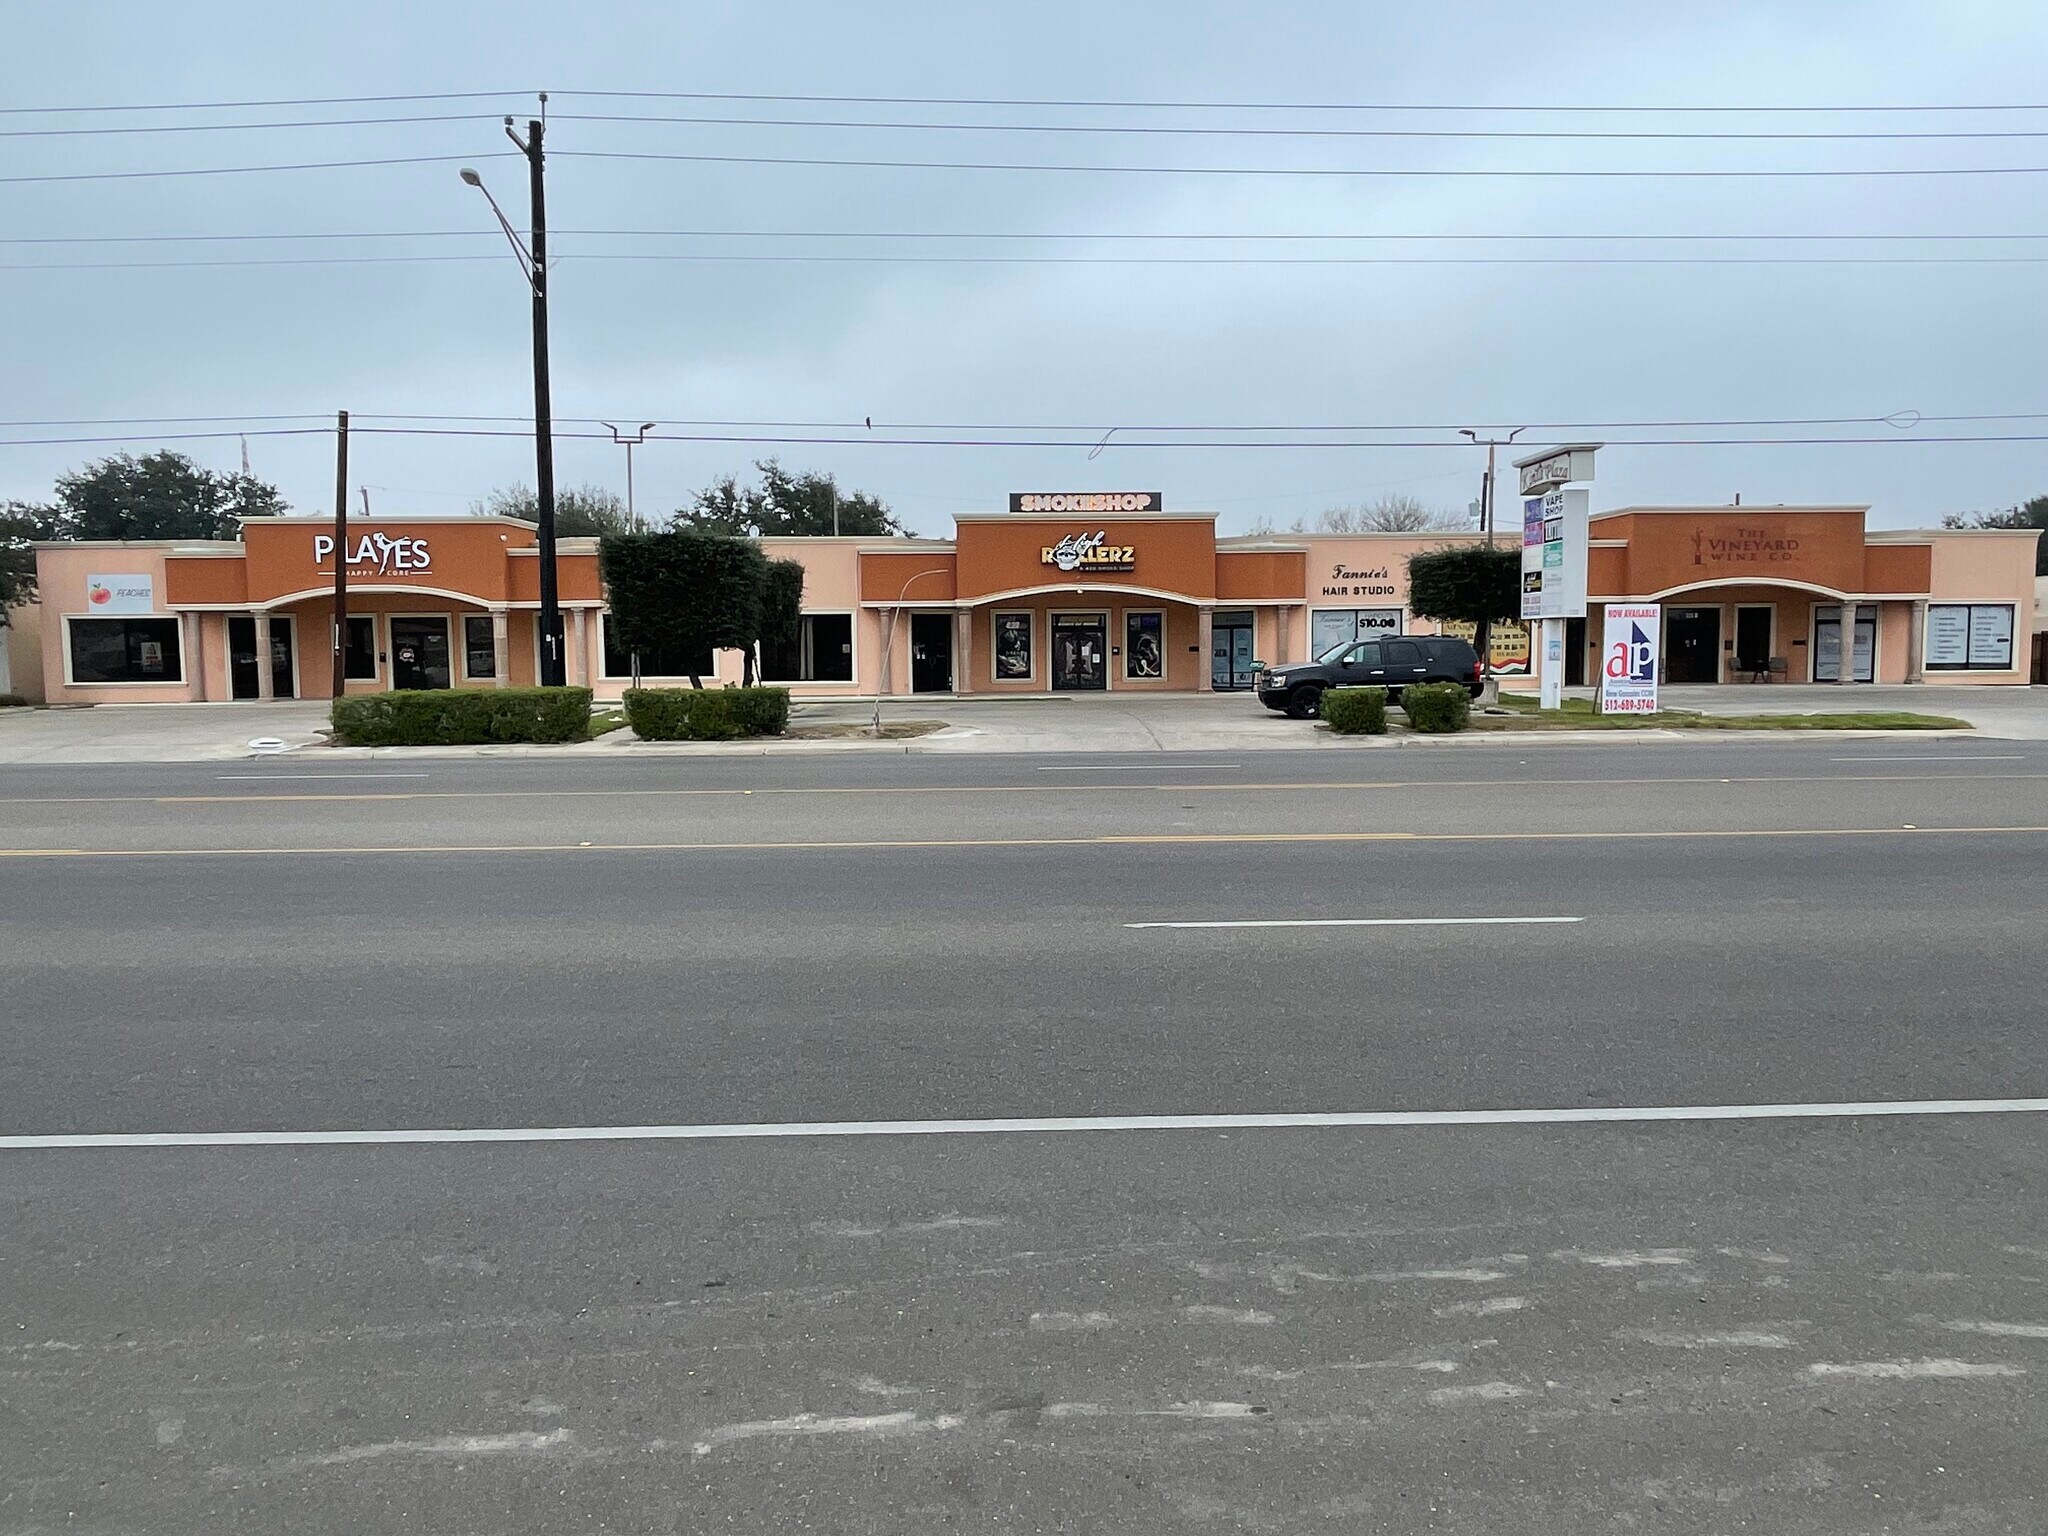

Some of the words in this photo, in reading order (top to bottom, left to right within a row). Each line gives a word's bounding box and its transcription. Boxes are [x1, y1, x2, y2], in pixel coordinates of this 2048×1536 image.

[1546, 494, 1563, 507] VAPE
[1545, 505, 1563, 517] SHOP
[1738, 529, 1767, 538] THE
[314, 532, 431, 568] PLATES
[1708, 540, 1799, 551] VINEYARD
[1711, 552, 1758, 561] WINE
[1332, 564, 1388, 579] Fannie's
[1322, 586, 1348, 596] HAIR
[1353, 585, 1395, 595] STUDIO
[1608, 609, 1623, 618] NOW
[1360, 618, 1395, 628] $10.00
[1605, 699, 1655, 711] 512-689-5740
